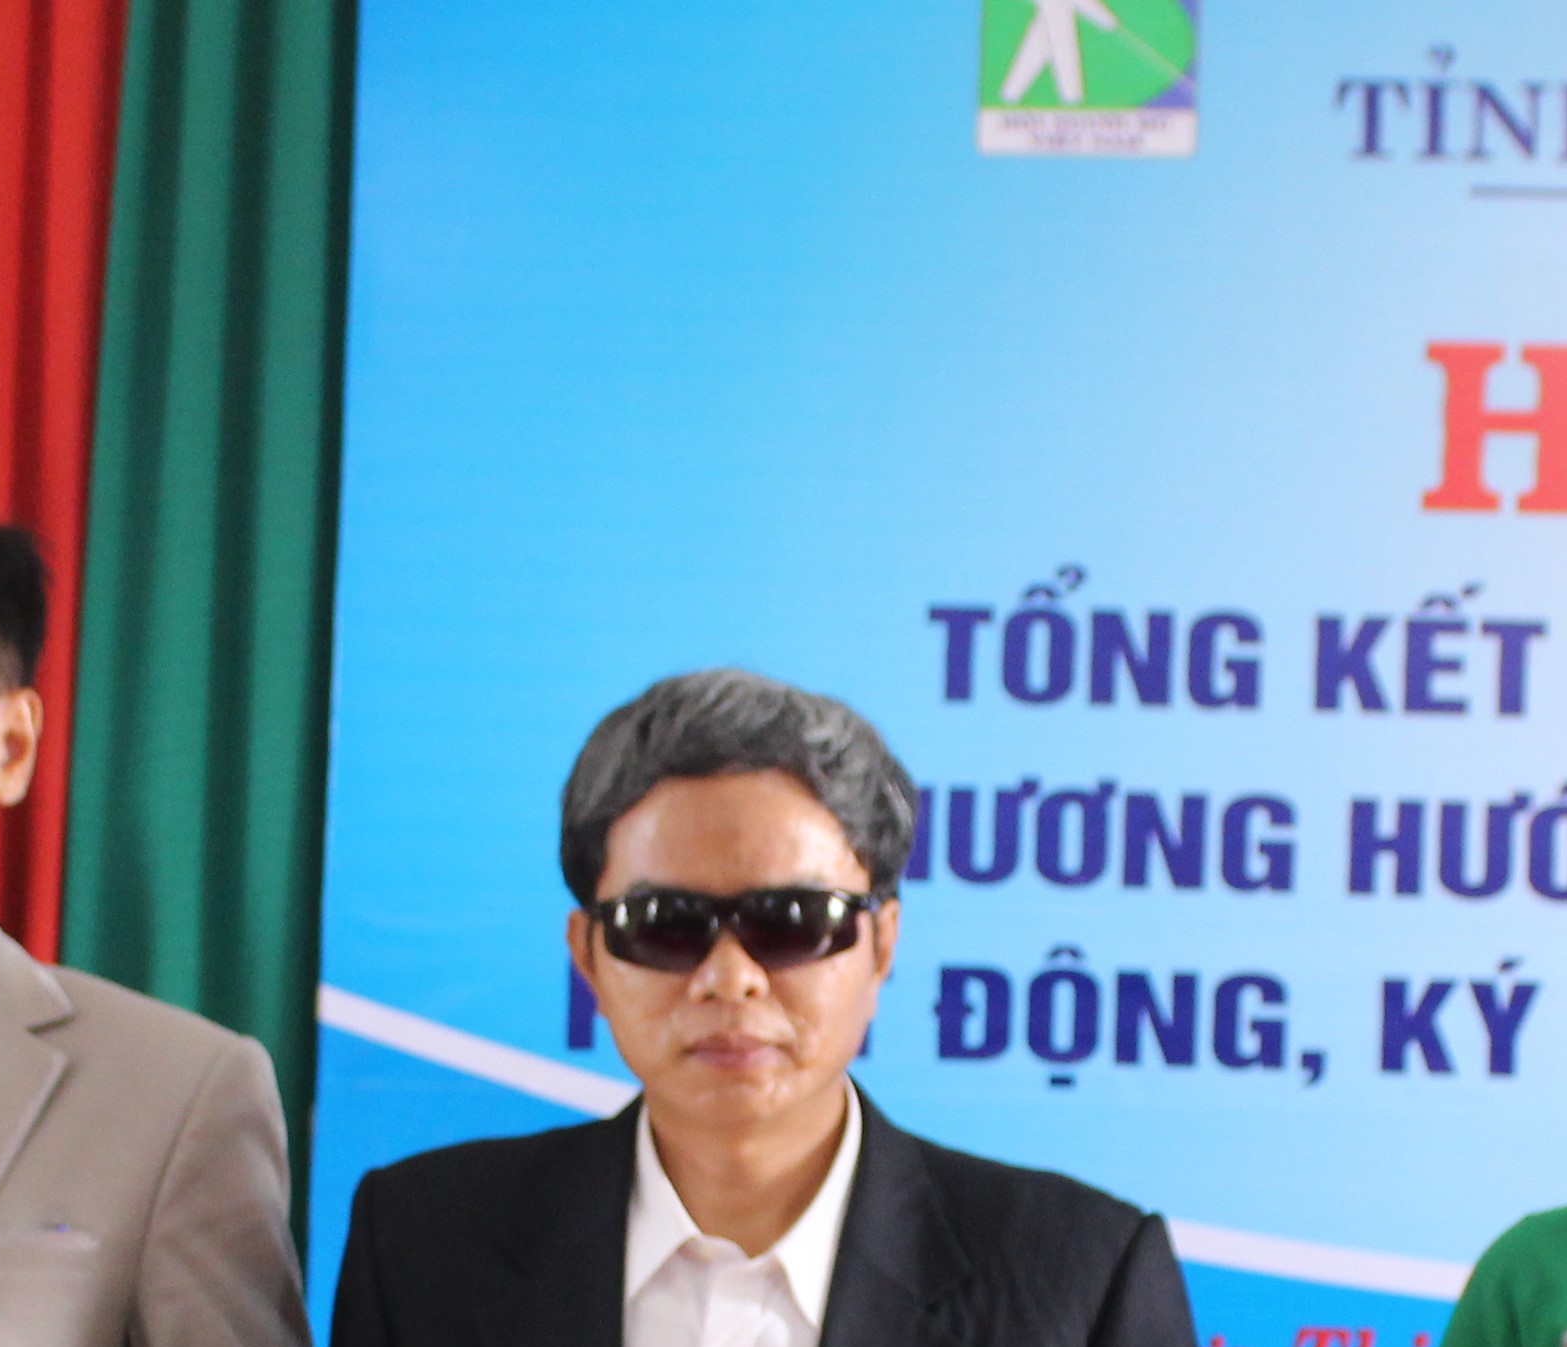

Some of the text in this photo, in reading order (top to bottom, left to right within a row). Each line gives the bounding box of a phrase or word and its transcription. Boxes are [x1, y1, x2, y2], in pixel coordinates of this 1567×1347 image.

[927, 565, 1264, 711] TỔNG
[1313, 584, 1548, 718] KẾT
[906, 776, 1297, 893] ƯƠNG
[932, 946, 1327, 1087] ĐỘNG,
[1379, 958, 1539, 1077] KÝ
